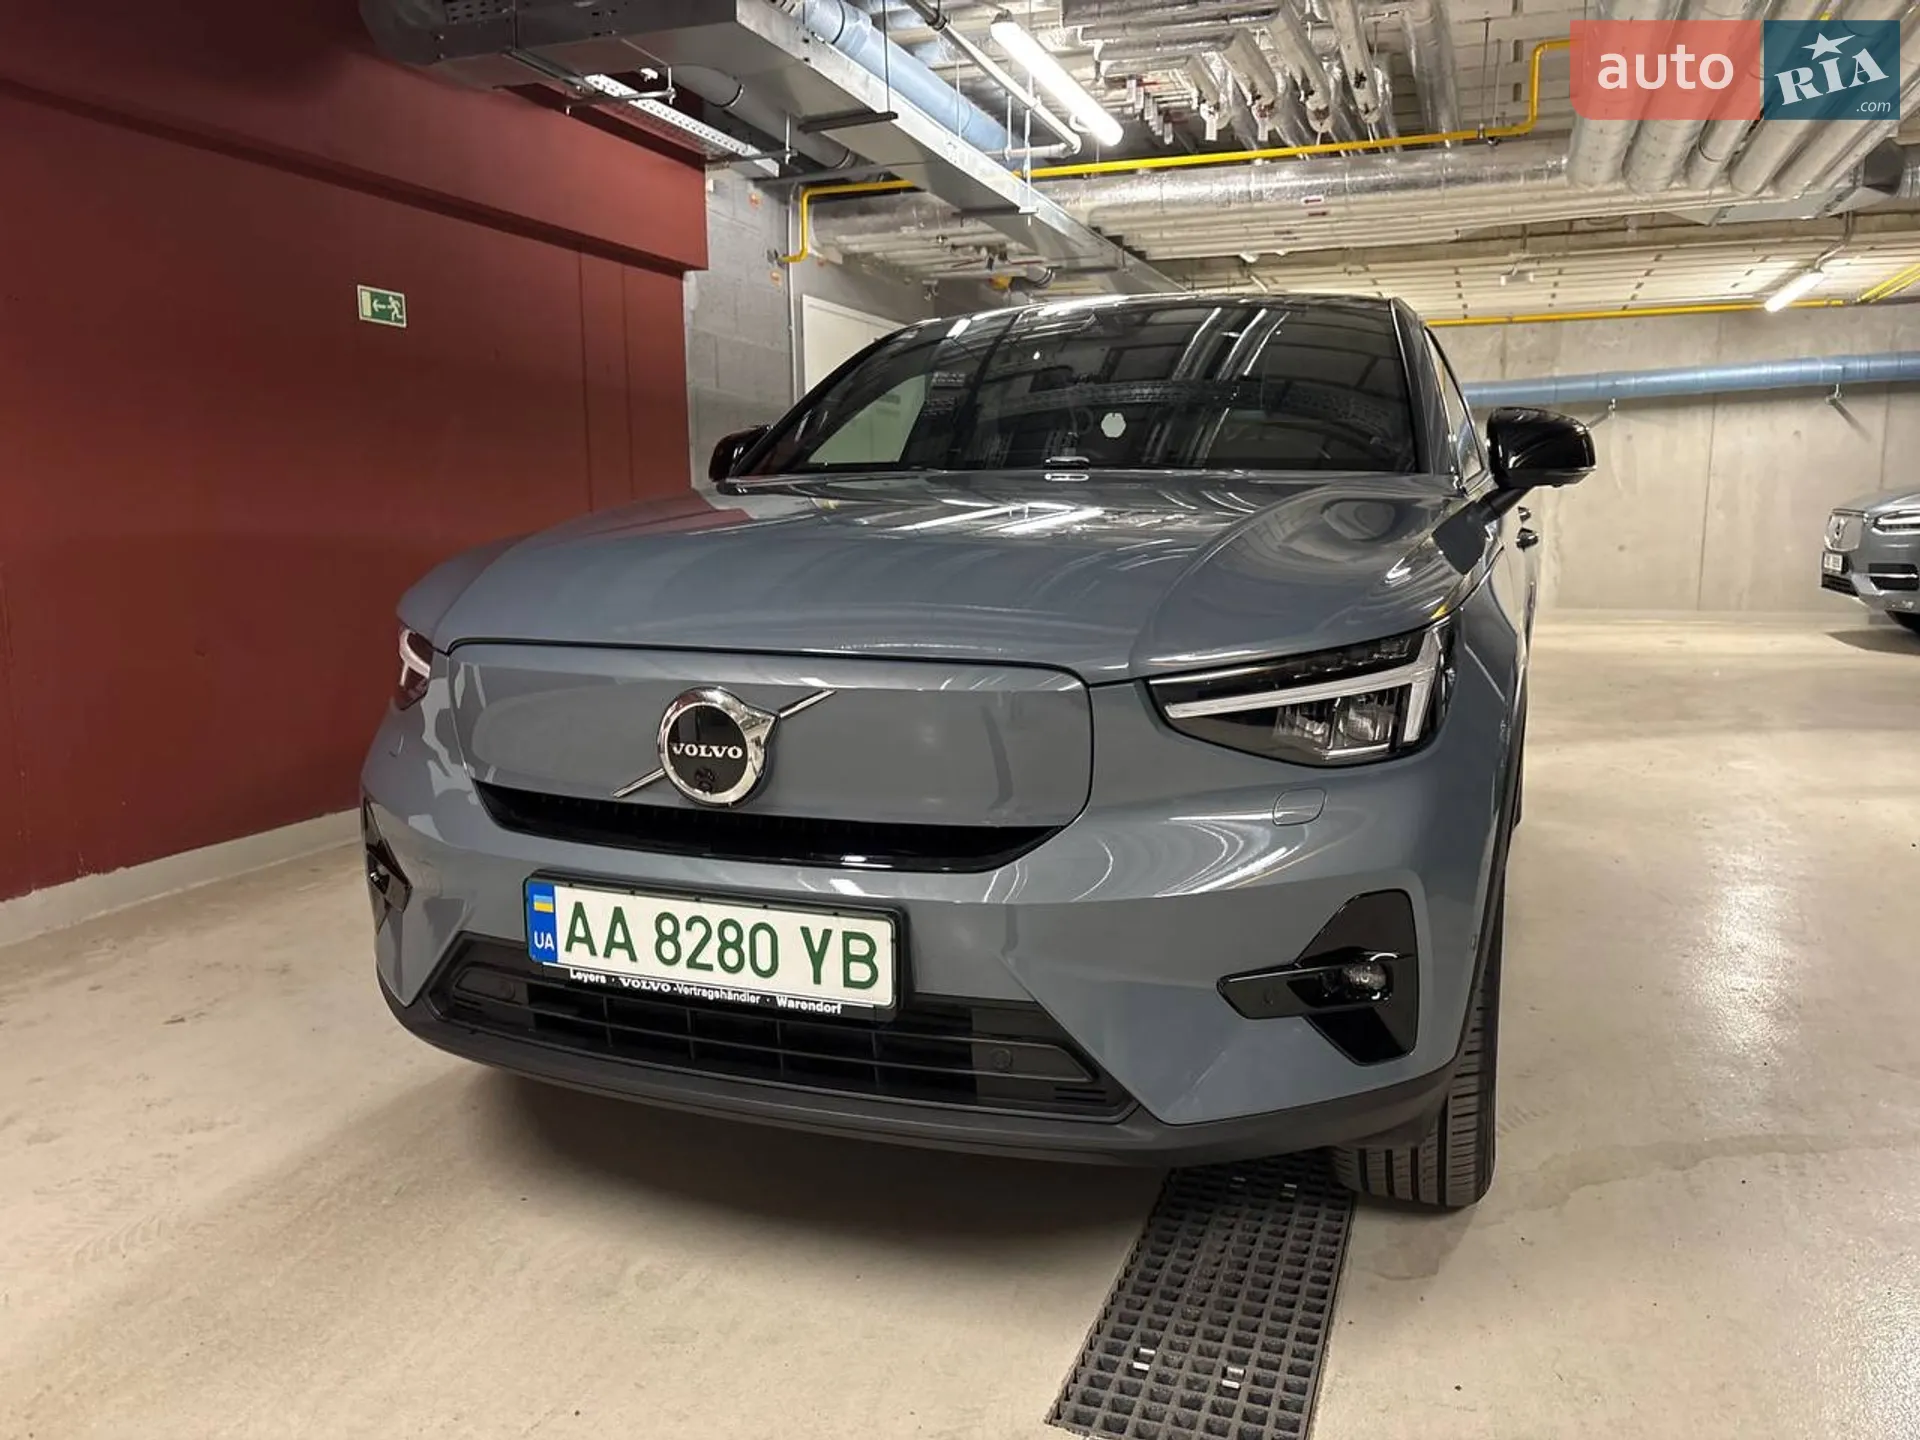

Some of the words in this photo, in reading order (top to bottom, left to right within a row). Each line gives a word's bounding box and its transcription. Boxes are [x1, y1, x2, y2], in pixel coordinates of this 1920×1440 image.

[672, 742, 743, 759] VOLVO
[533, 930, 555, 951] UA
[564, 901, 638, 963] AA
[654, 911, 779, 979] 8280
[800, 925, 880, 990] YB
[619, 976, 672, 993] VOLVO
[776, 995, 843, 1015] Warendorf
